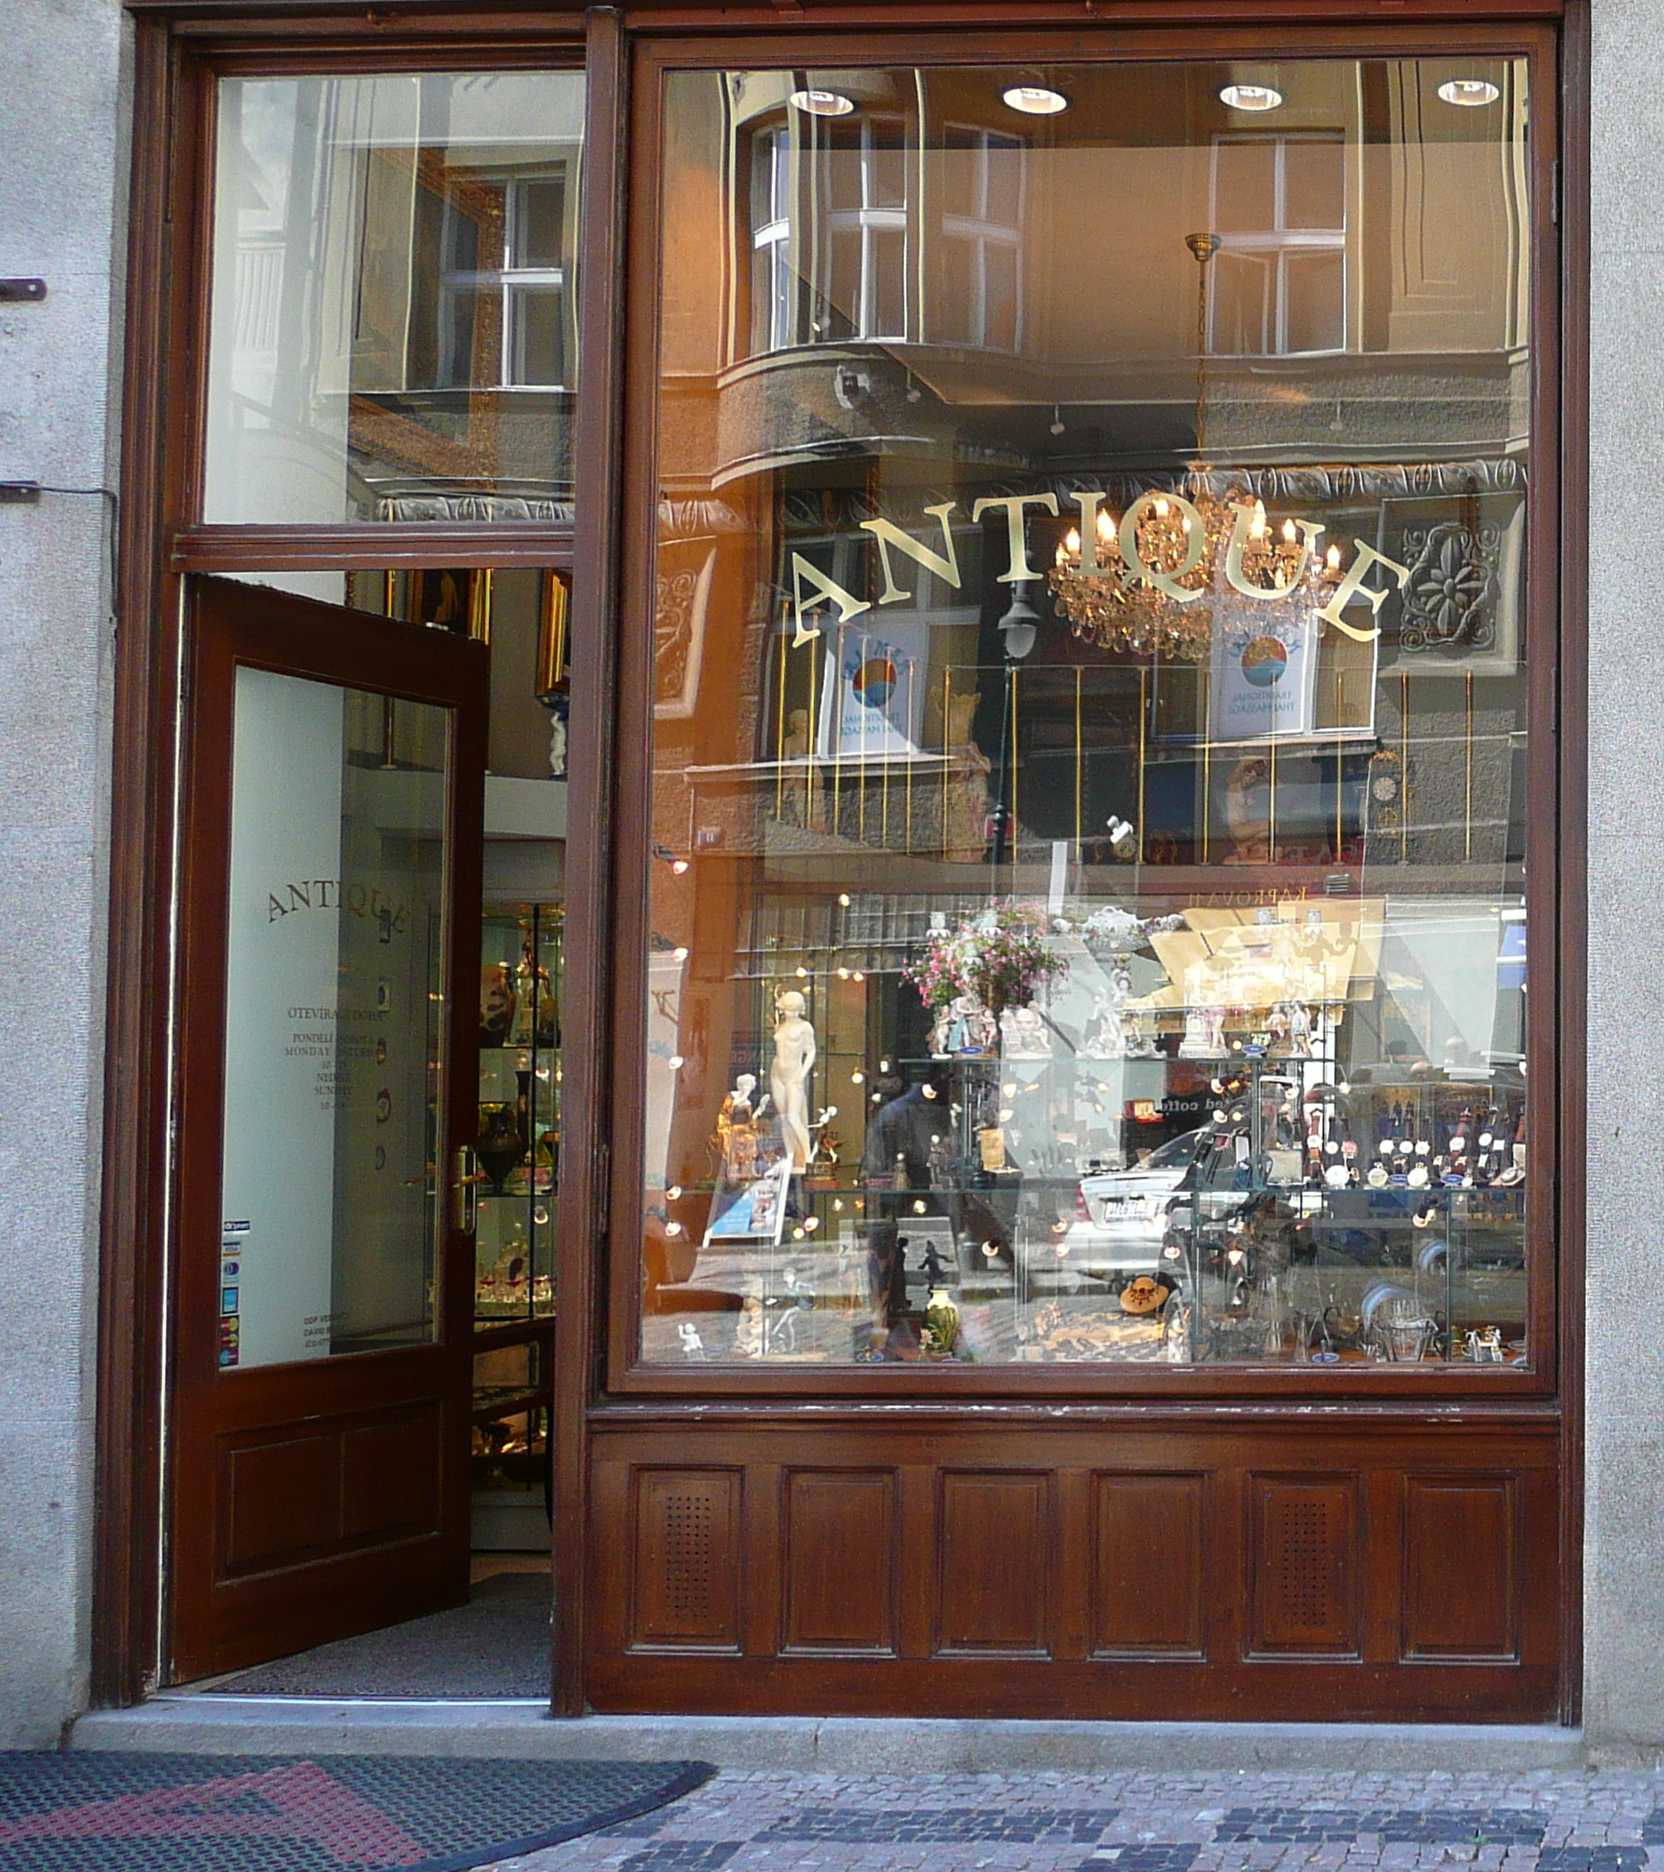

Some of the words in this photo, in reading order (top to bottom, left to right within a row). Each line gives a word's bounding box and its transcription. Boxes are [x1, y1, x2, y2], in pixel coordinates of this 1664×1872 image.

[790, 490, 1412, 648] ANTIQUE
[269, 880, 411, 933] ANTIQUE
[284, 1047, 330, 1057] MONDAY
